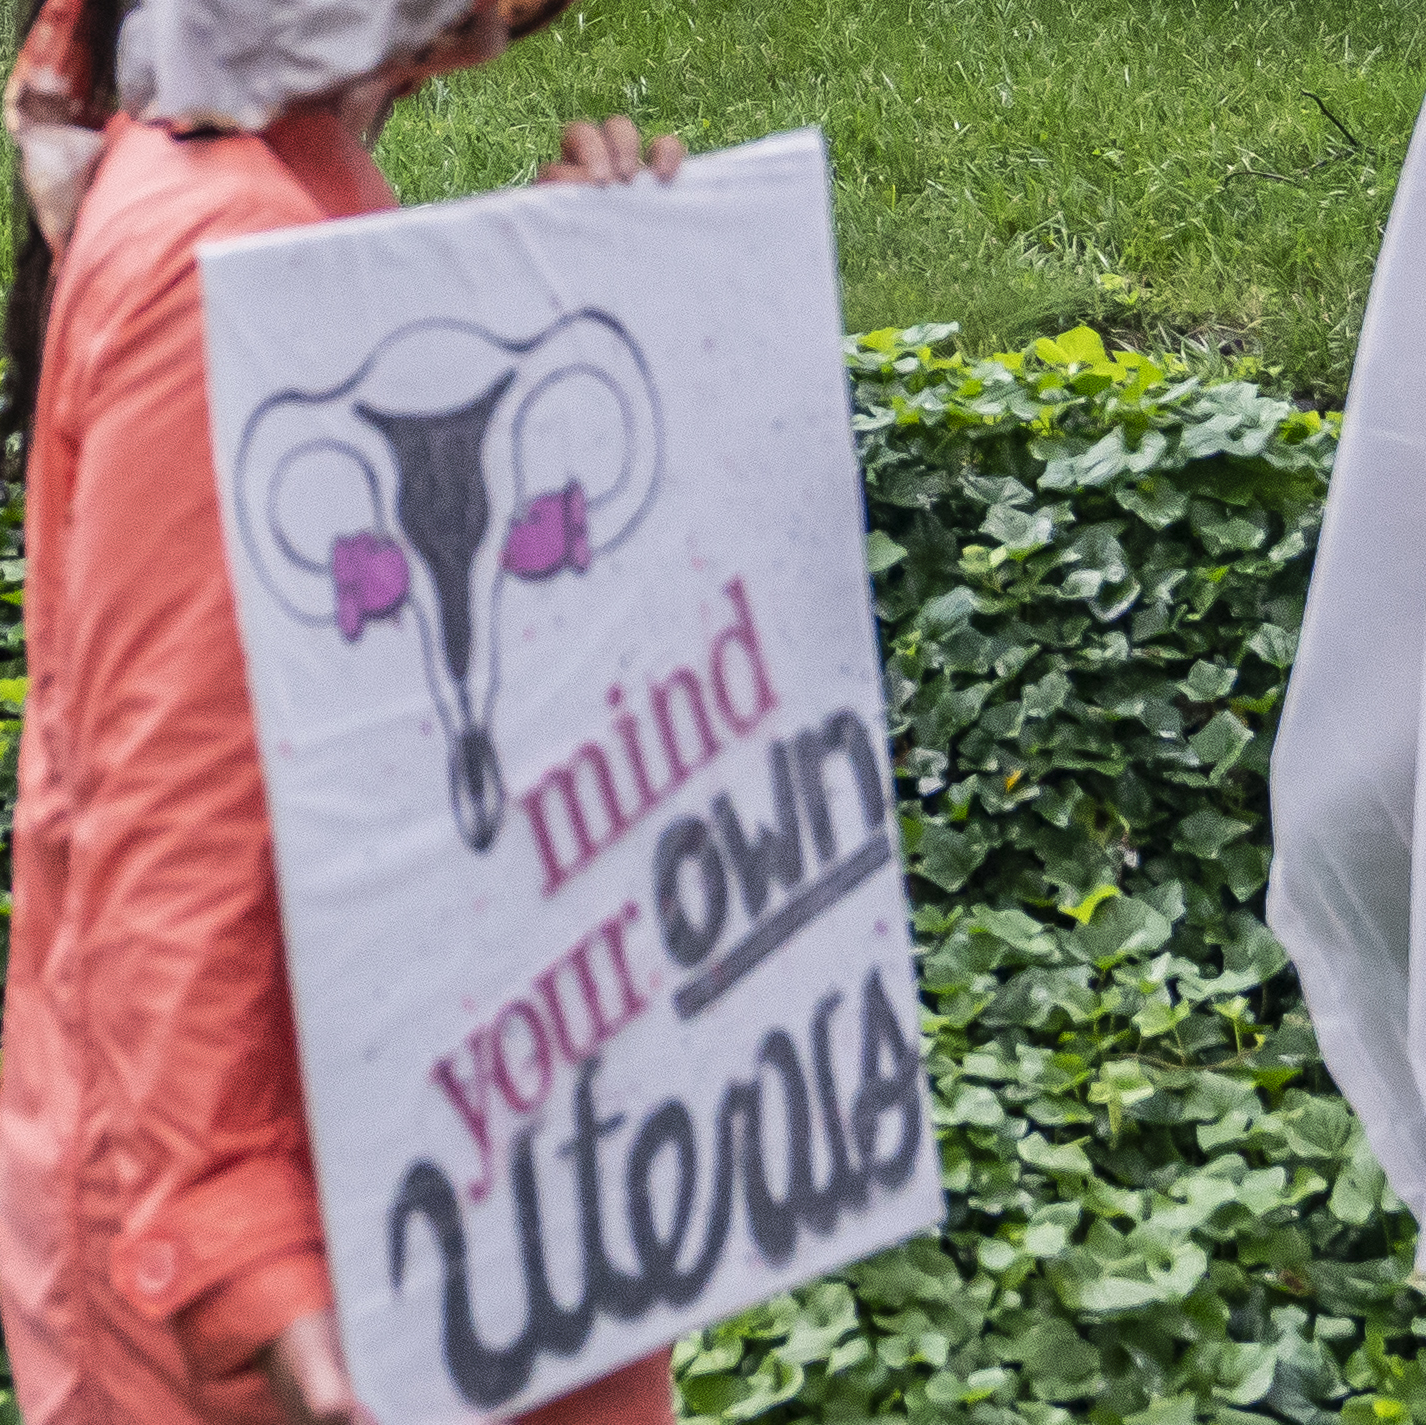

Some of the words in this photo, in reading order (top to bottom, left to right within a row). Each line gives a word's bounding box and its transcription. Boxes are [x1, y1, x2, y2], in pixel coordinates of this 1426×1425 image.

[515, 576, 778, 897] mind
[433, 901, 647, 1201] your
[654, 706, 886, 967] own
